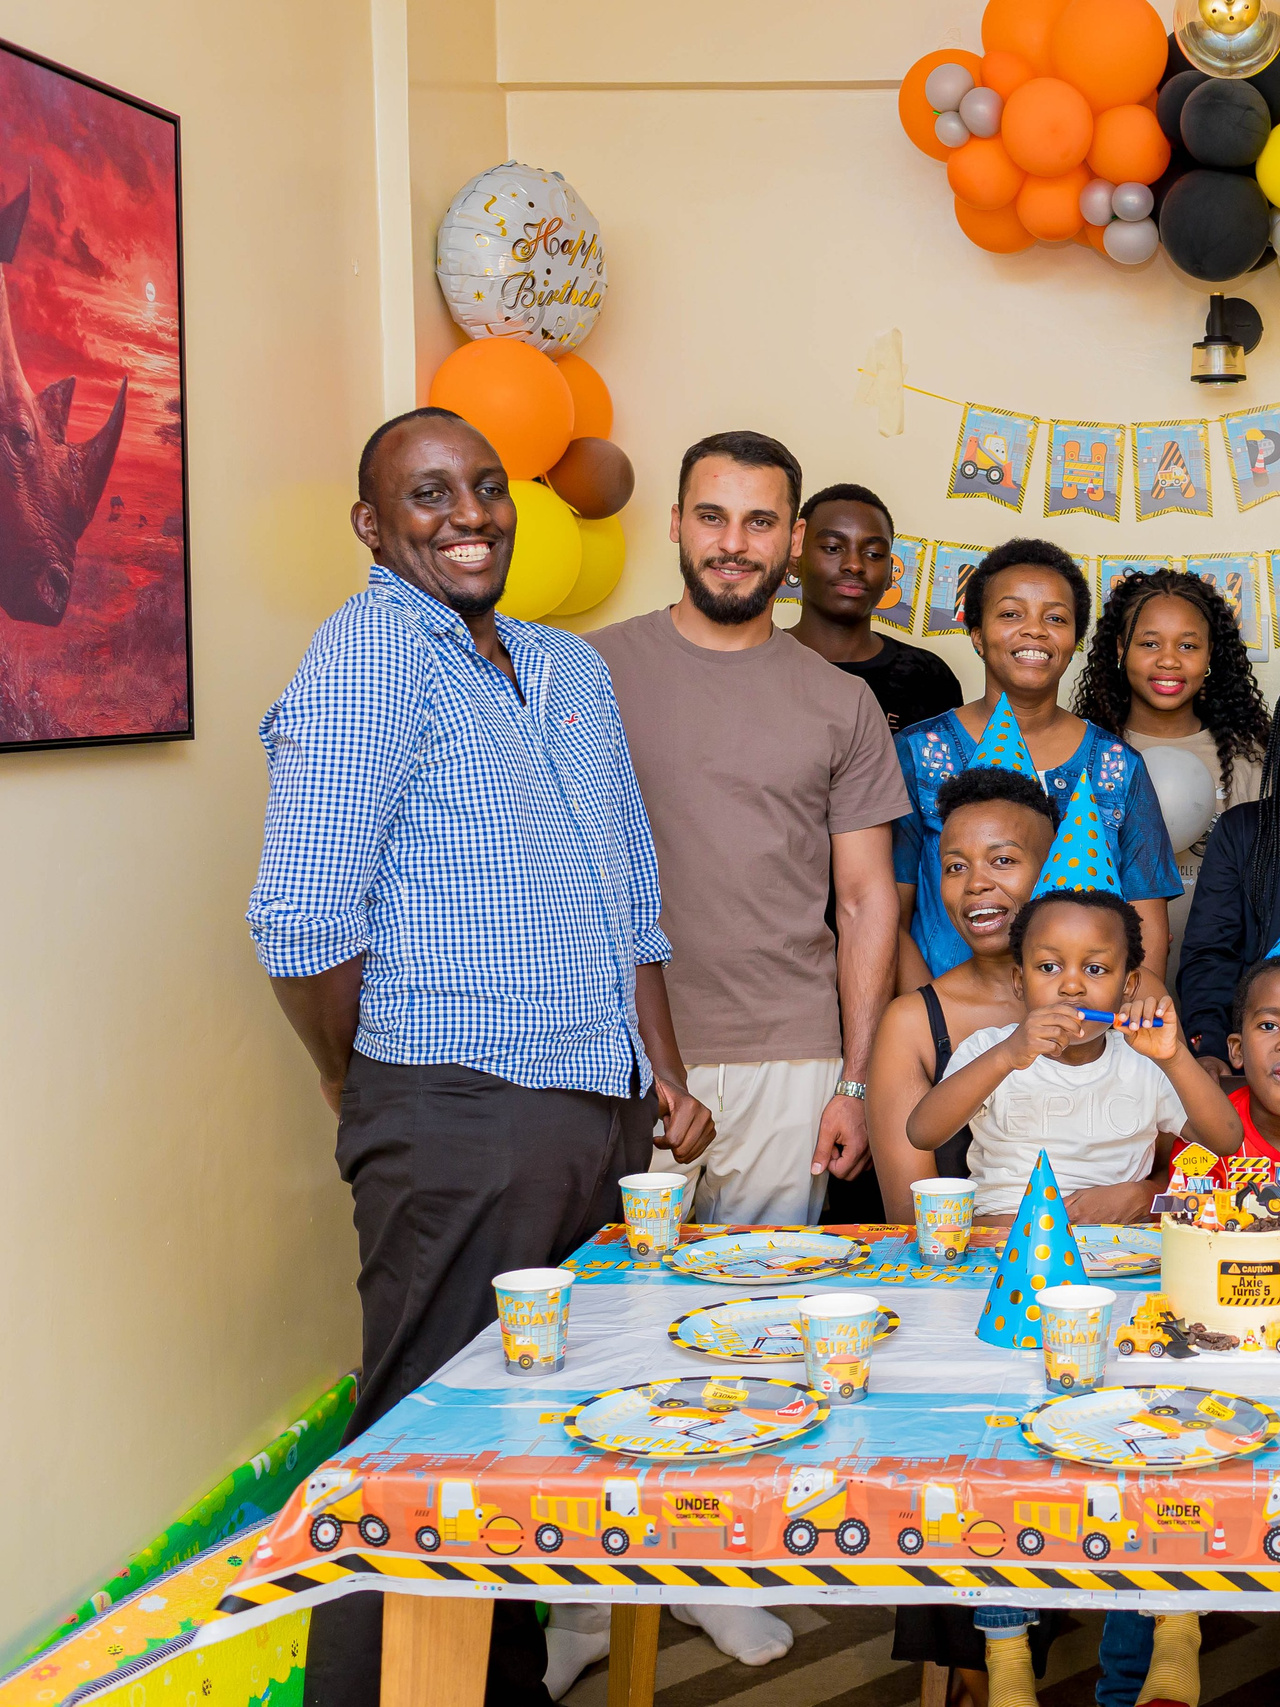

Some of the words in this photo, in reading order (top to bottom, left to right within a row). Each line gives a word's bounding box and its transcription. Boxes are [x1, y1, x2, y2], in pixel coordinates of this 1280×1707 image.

[512, 217, 606, 274] Happy
[501, 270, 601, 309] Birthda
[1005, 1092, 1141, 1137] EPIC
[1182, 1156, 1198, 1165] DIG
[1199, 1155, 1208, 1164] IN
[1242, 1264, 1273, 1273] CAUTION
[1239, 1276, 1263, 1288] Axie
[1232, 1285, 1261, 1297] Turns
[1263, 1285, 1271, 1297] 5
[675, 1497, 719, 1511] UNDER
[1156, 1503, 1201, 1518] UNDER
